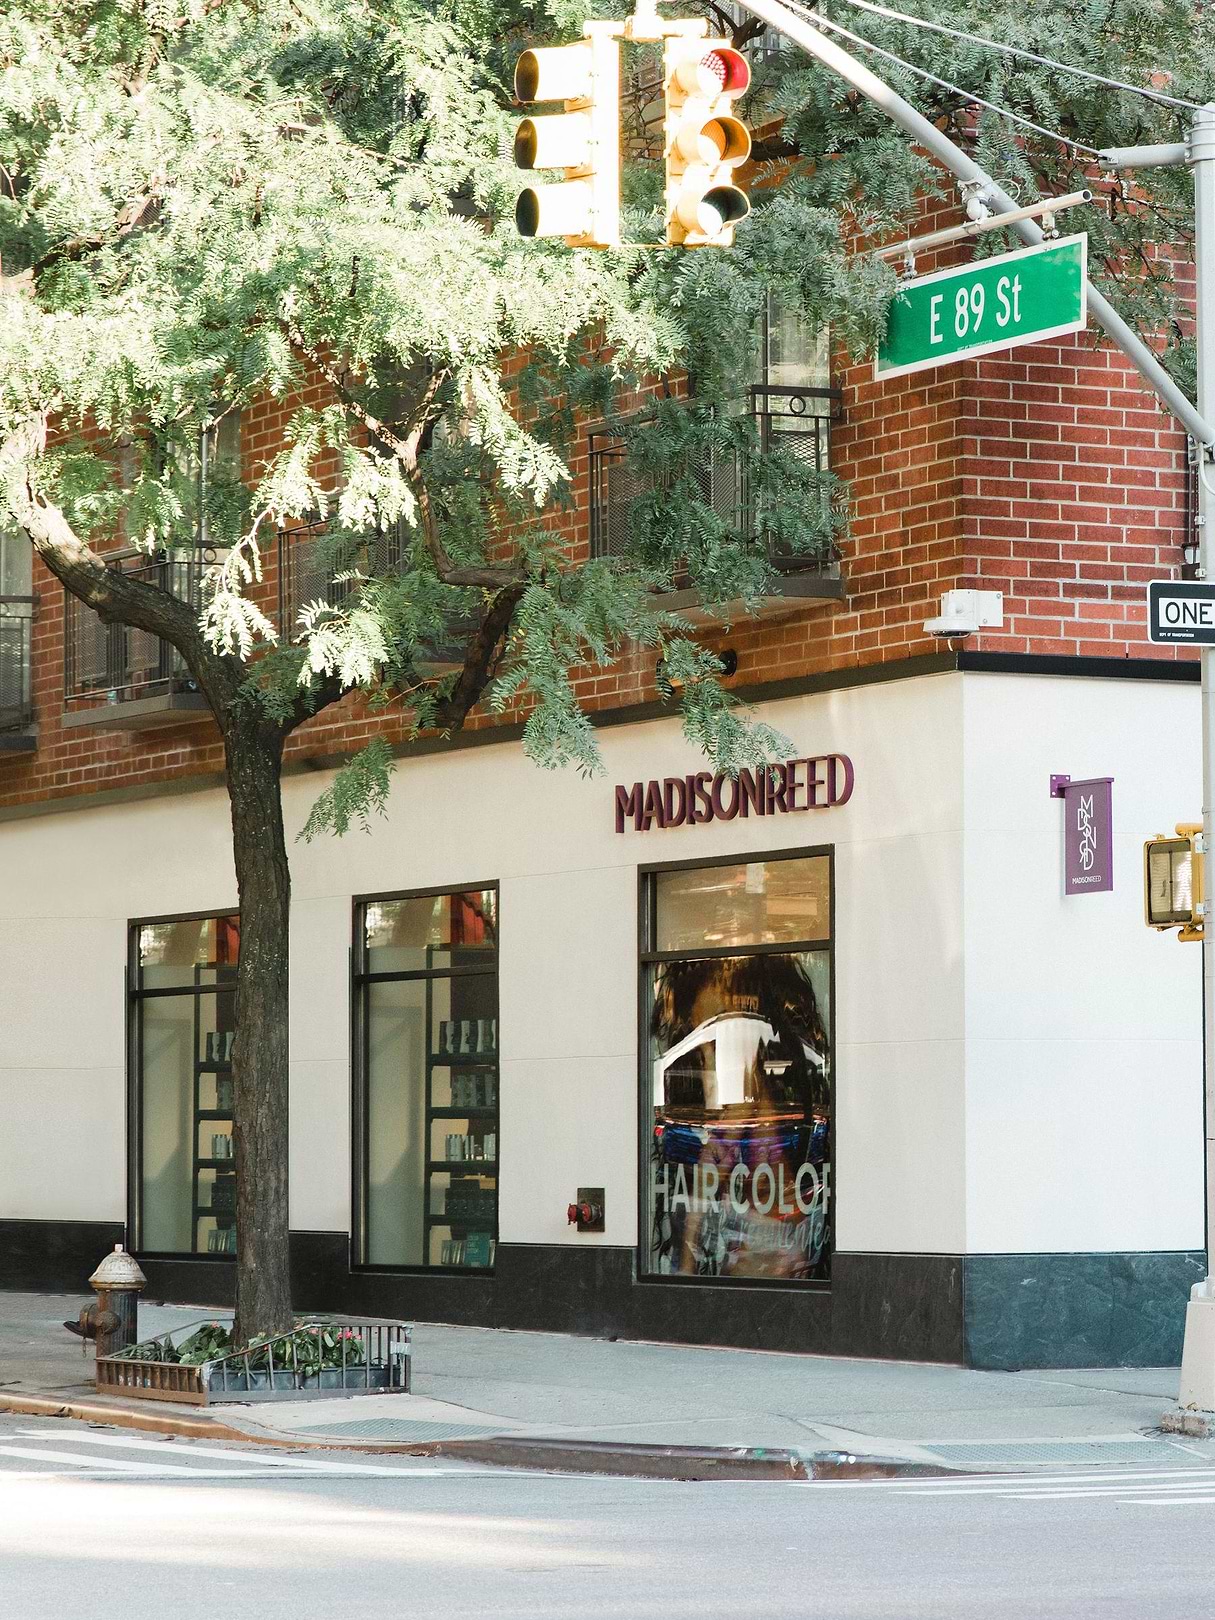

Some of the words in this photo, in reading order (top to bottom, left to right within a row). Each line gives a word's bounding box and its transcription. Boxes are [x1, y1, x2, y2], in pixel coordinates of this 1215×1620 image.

[930, 293, 944, 345] E
[954, 282, 985, 338] 89
[995, 273, 1022, 327] St
[1165, 601, 1213, 625] ONE
[615, 753, 855, 833] MADISONREED
[651, 1162, 720, 1214] HAIR
